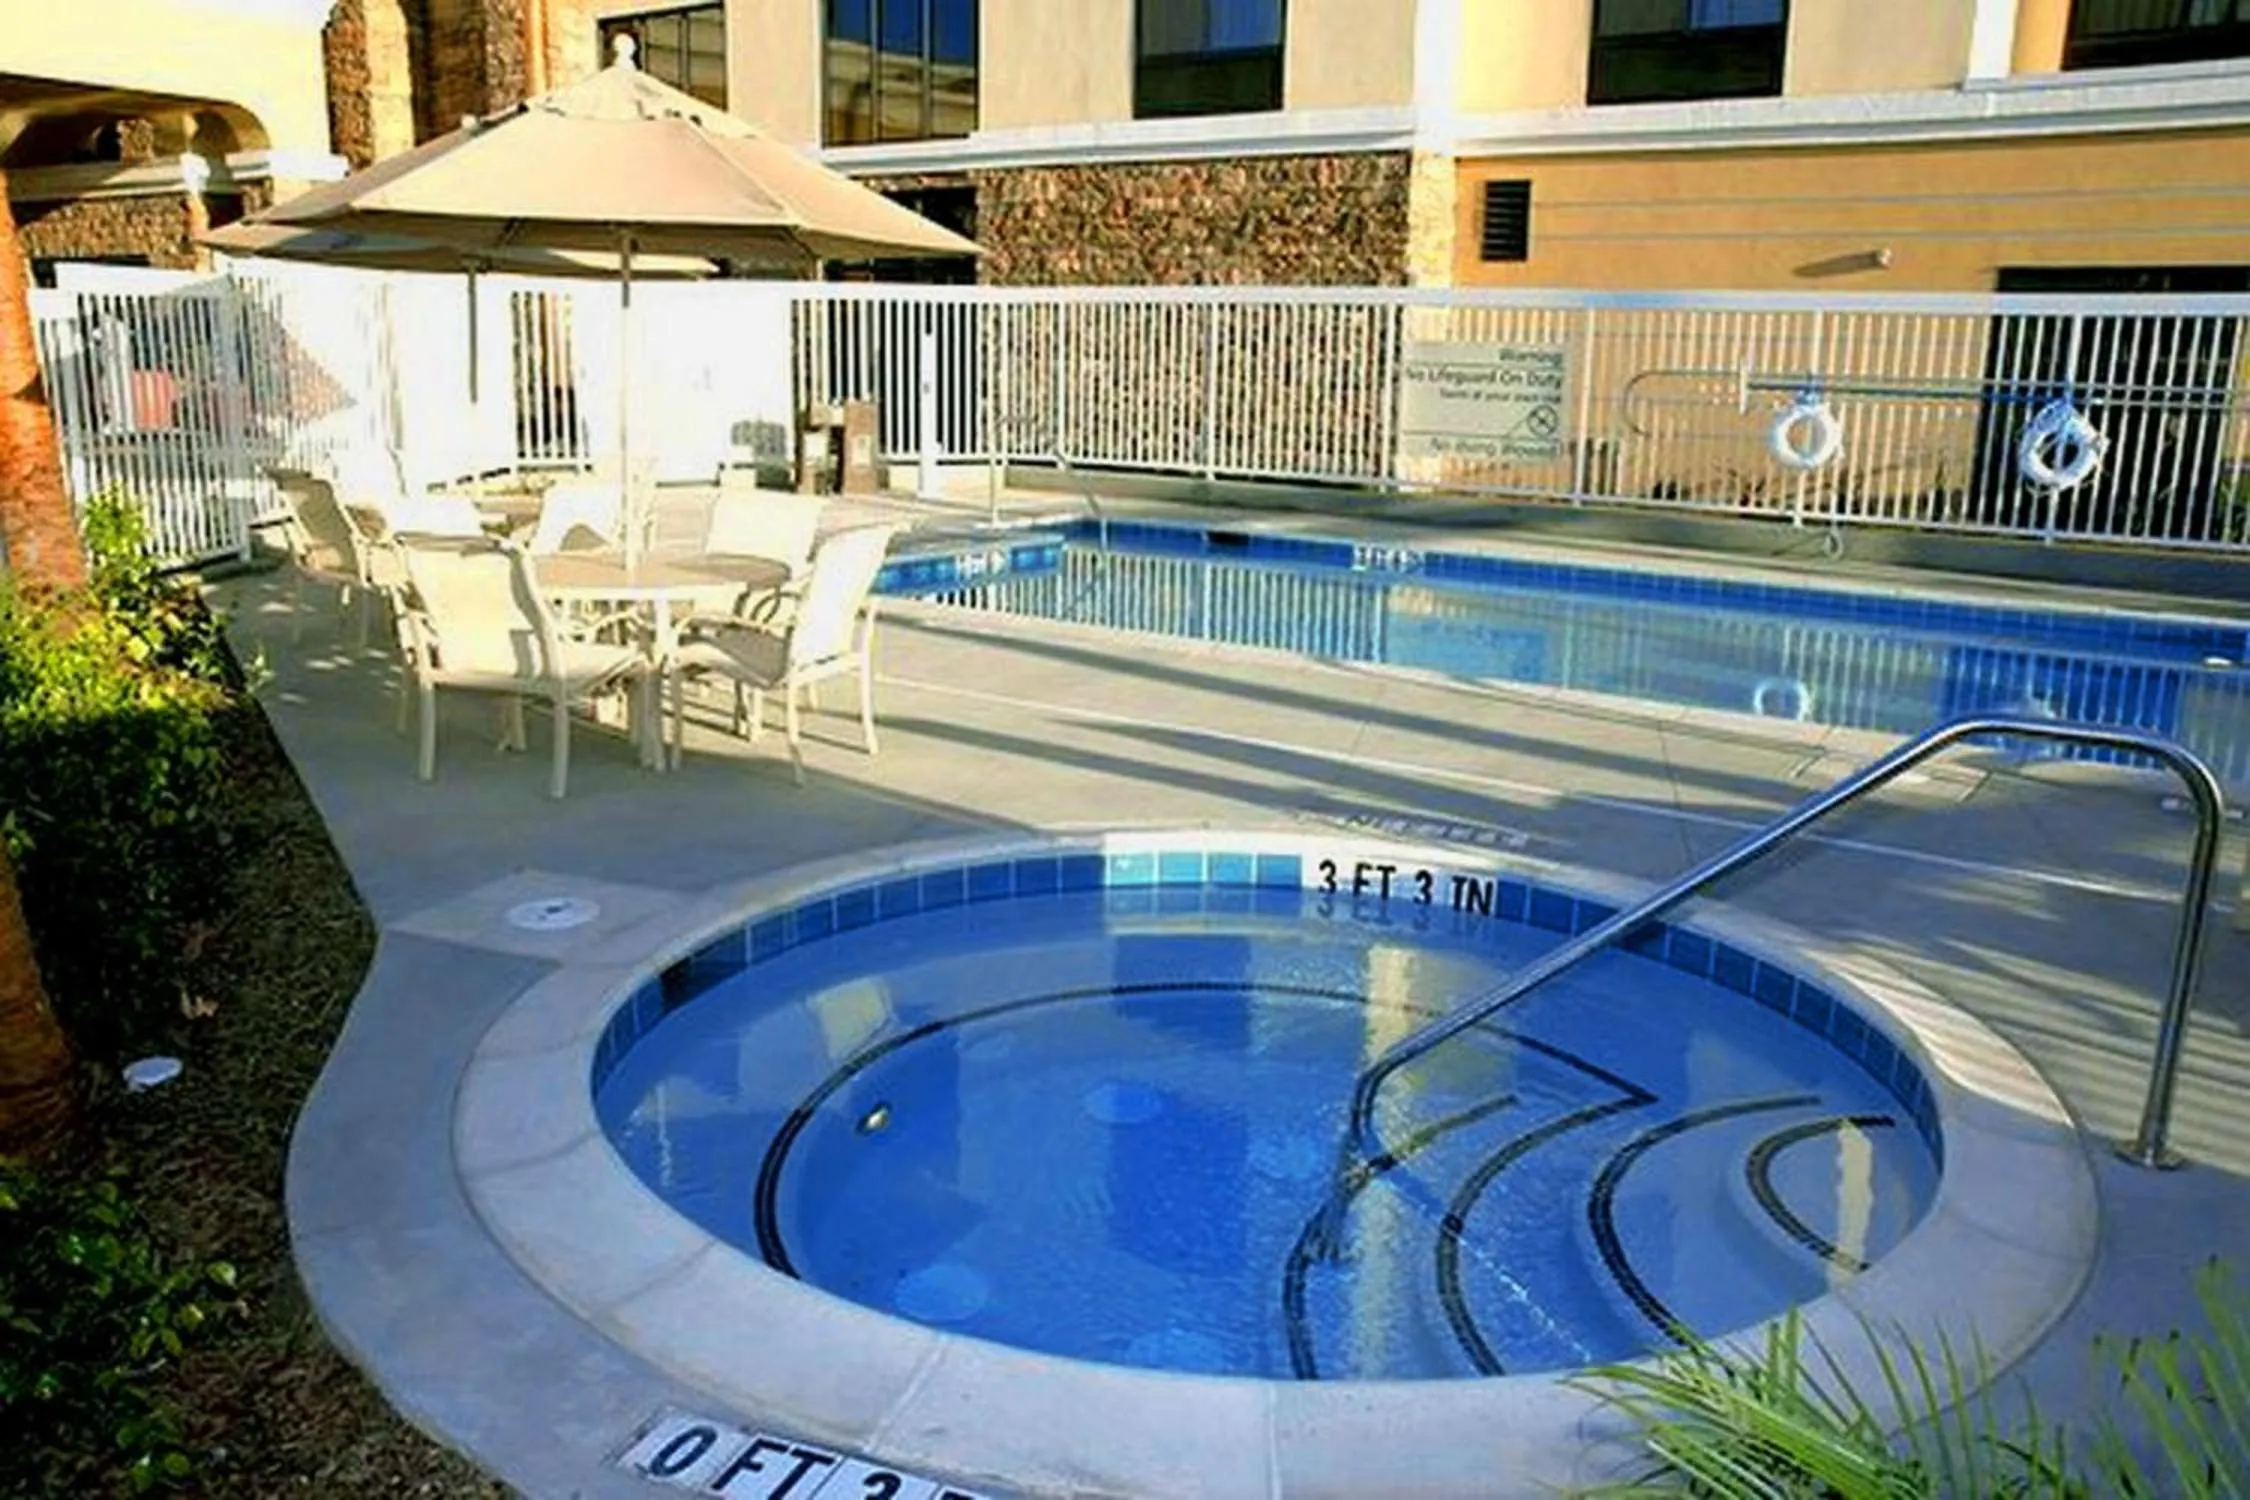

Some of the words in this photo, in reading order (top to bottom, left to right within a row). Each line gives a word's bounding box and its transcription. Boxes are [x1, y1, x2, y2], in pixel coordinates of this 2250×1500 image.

[1428, 365, 1496, 385] Lifeguard
[1500, 369, 1522, 386] On
[1527, 371, 1561, 390] Duty
[1318, 859, 1337, 895] 3
[1353, 862, 1397, 903] FT
[1413, 869, 1433, 906] 3
[1452, 875, 1494, 916] IN
[711, 1437, 836, 1500] FT
